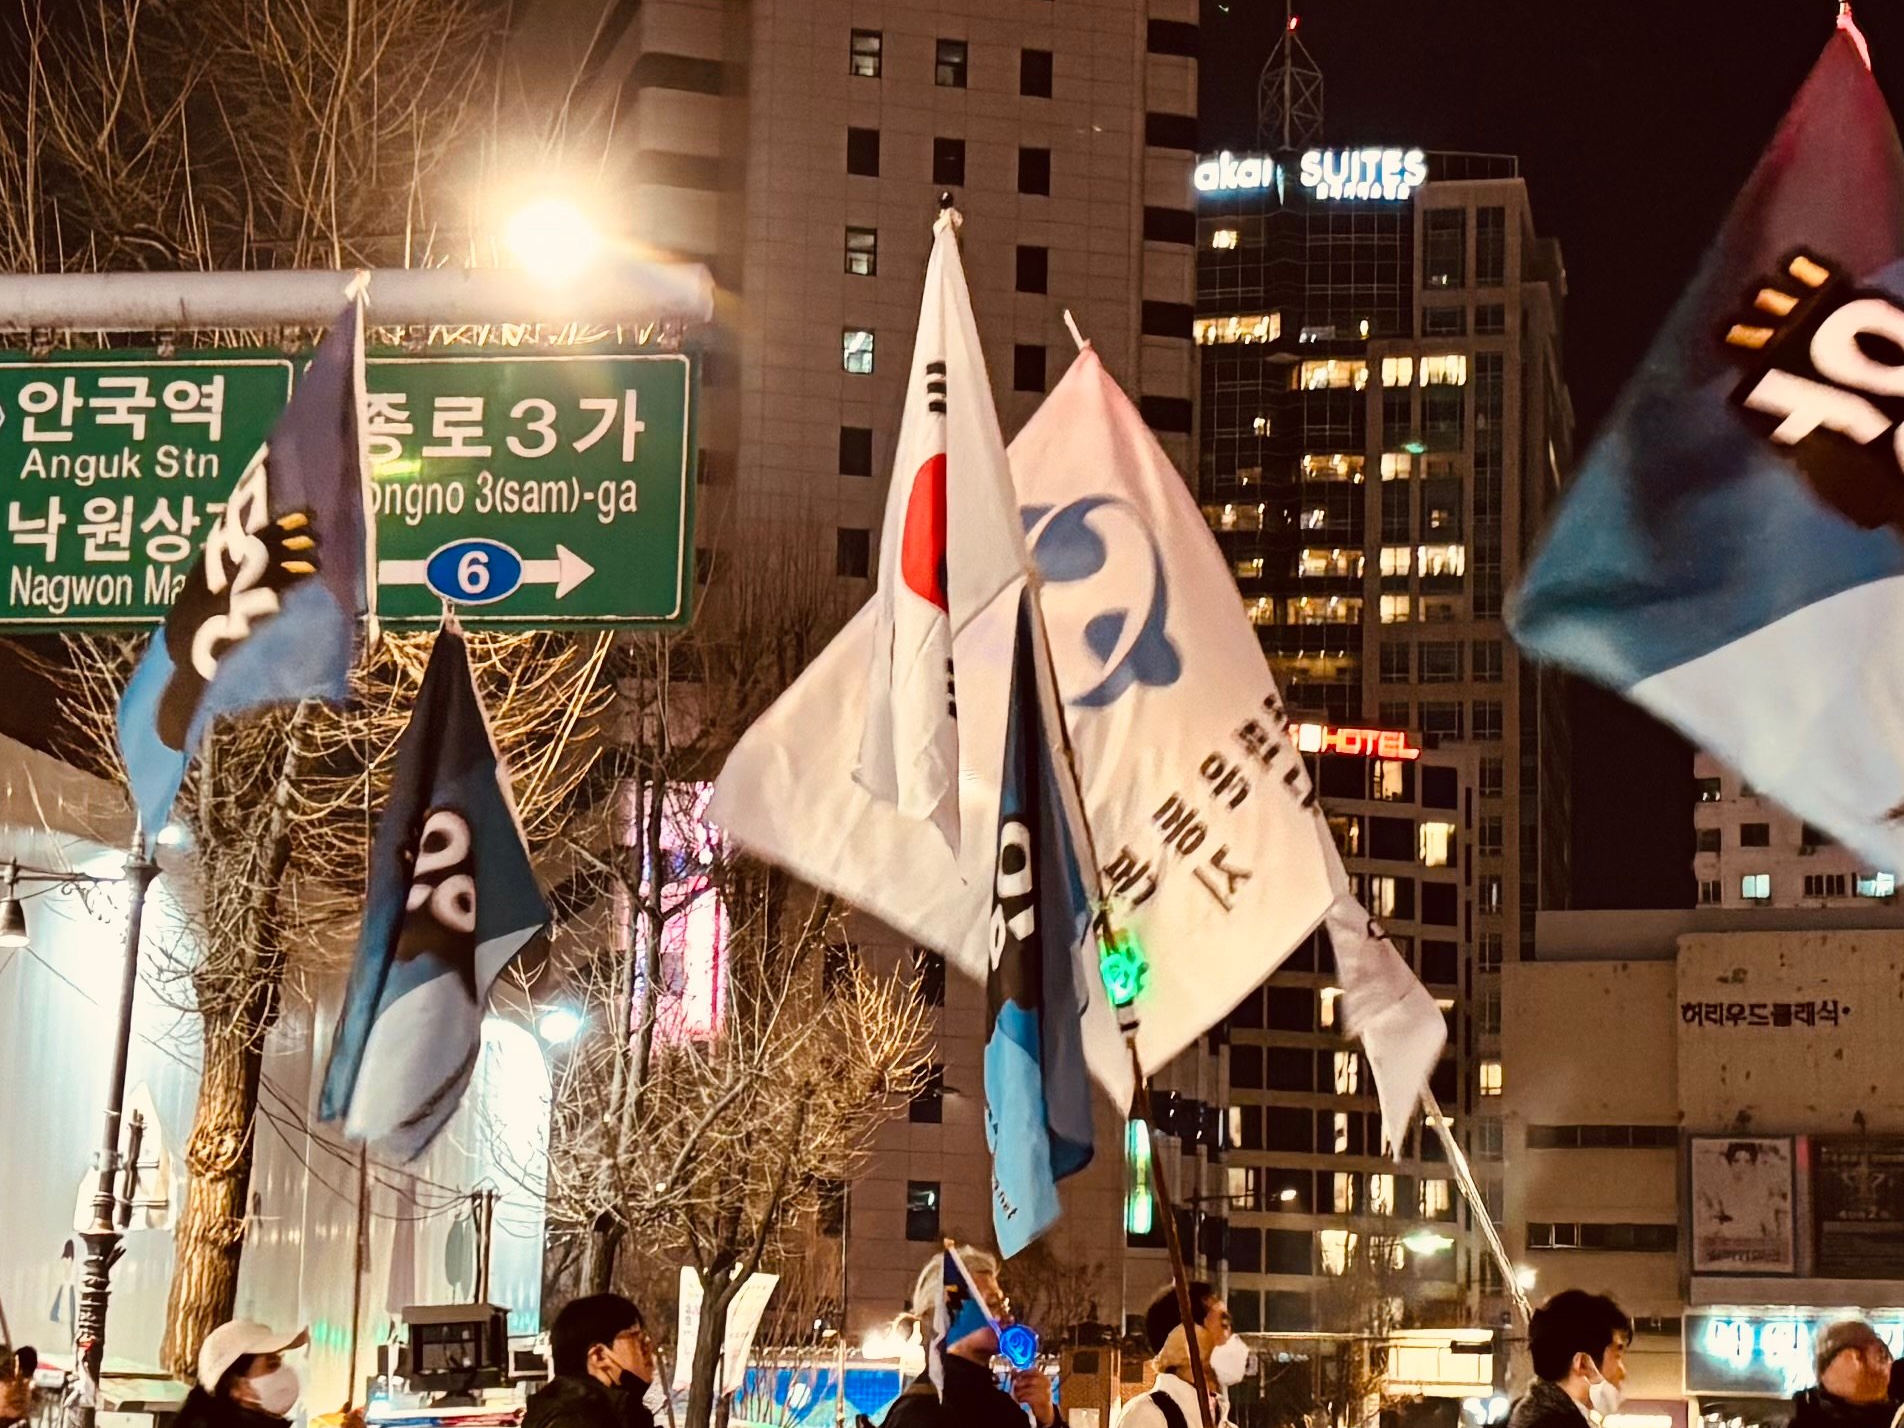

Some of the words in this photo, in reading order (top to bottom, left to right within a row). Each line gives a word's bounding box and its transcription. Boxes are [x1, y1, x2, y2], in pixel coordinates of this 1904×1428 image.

[1300, 149, 1427, 187] SUITES
[17, 374, 225, 442] 안국역
[20, 446, 141, 487] Anguk
[154, 445, 219, 478] Stn
[370, 479, 464, 526] ongno
[475, 470, 638, 525] 3(sam)-ga
[10, 564, 132, 614] Nagwon
[457, 550, 490, 595] 6
[1320, 725, 1421, 760] HOTEL
